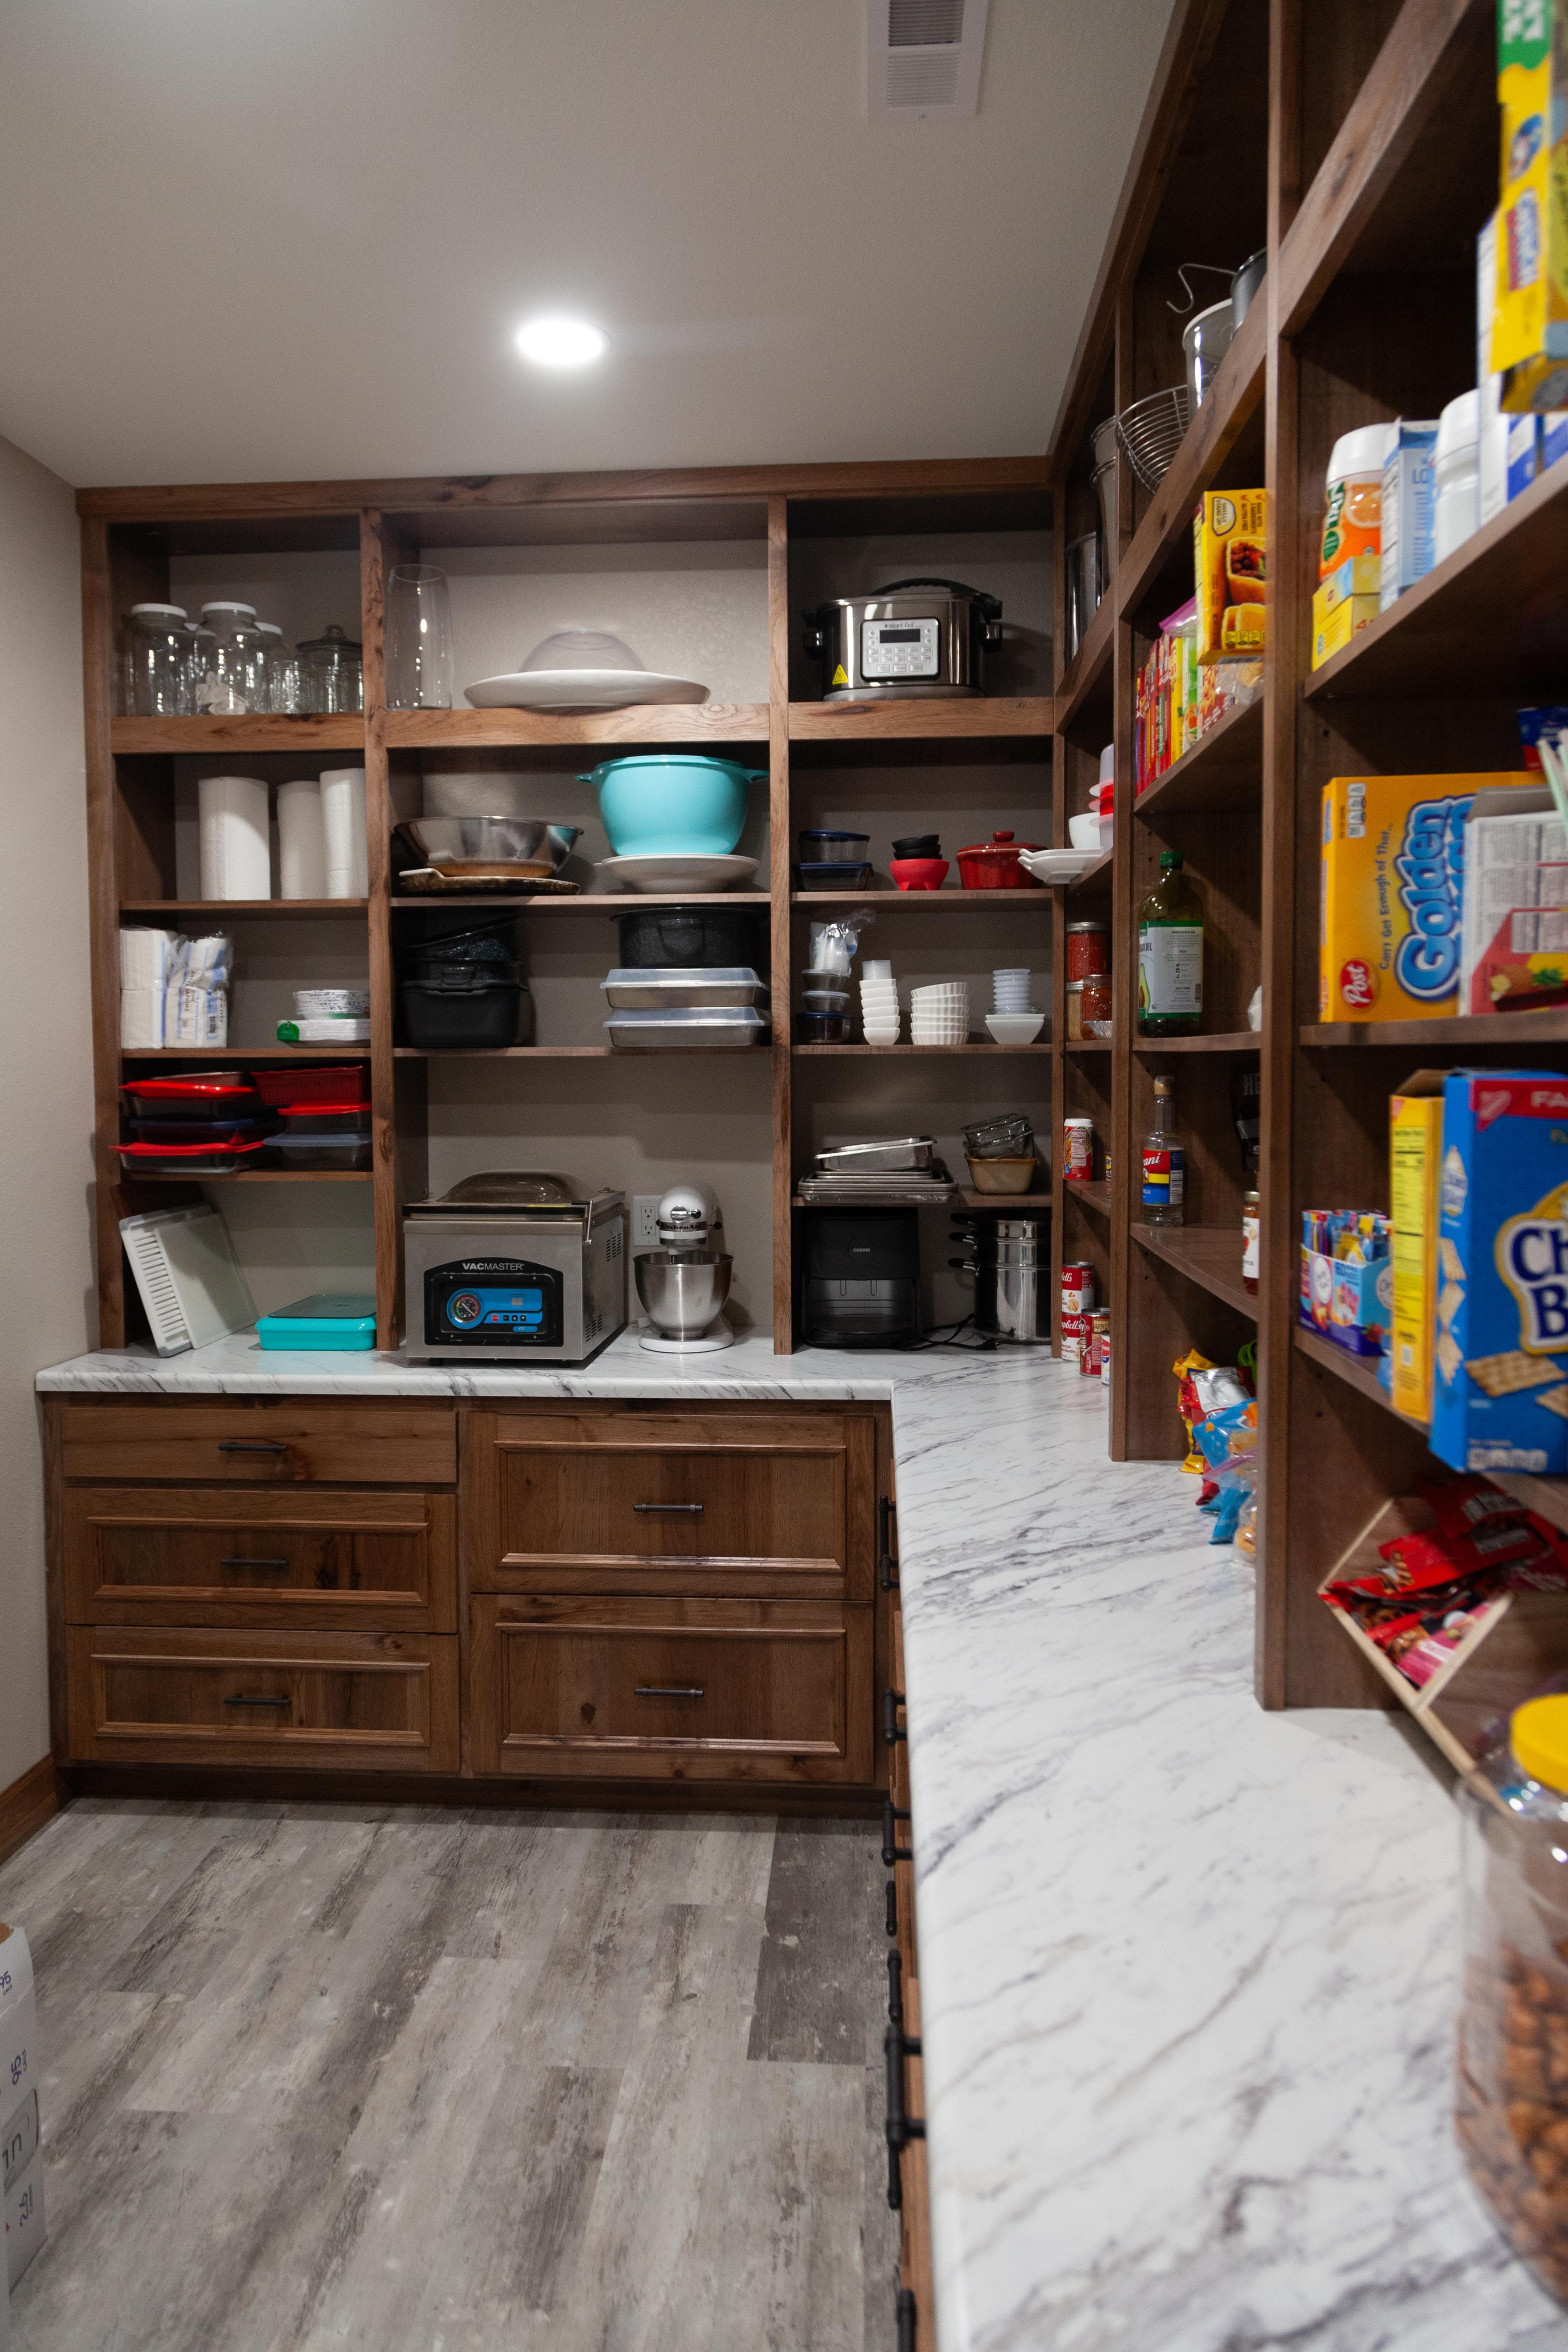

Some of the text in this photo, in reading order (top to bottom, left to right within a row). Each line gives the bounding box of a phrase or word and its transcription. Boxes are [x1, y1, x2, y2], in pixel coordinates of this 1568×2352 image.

[1375, 860, 1386, 871] of
[1375, 874, 1390, 915] Enough
[1395, 802, 1458, 998] Golden
[1382, 919, 1392, 937] Get
[1343, 963, 1371, 1004] Post
[12, 2054, 22, 2085] 95
